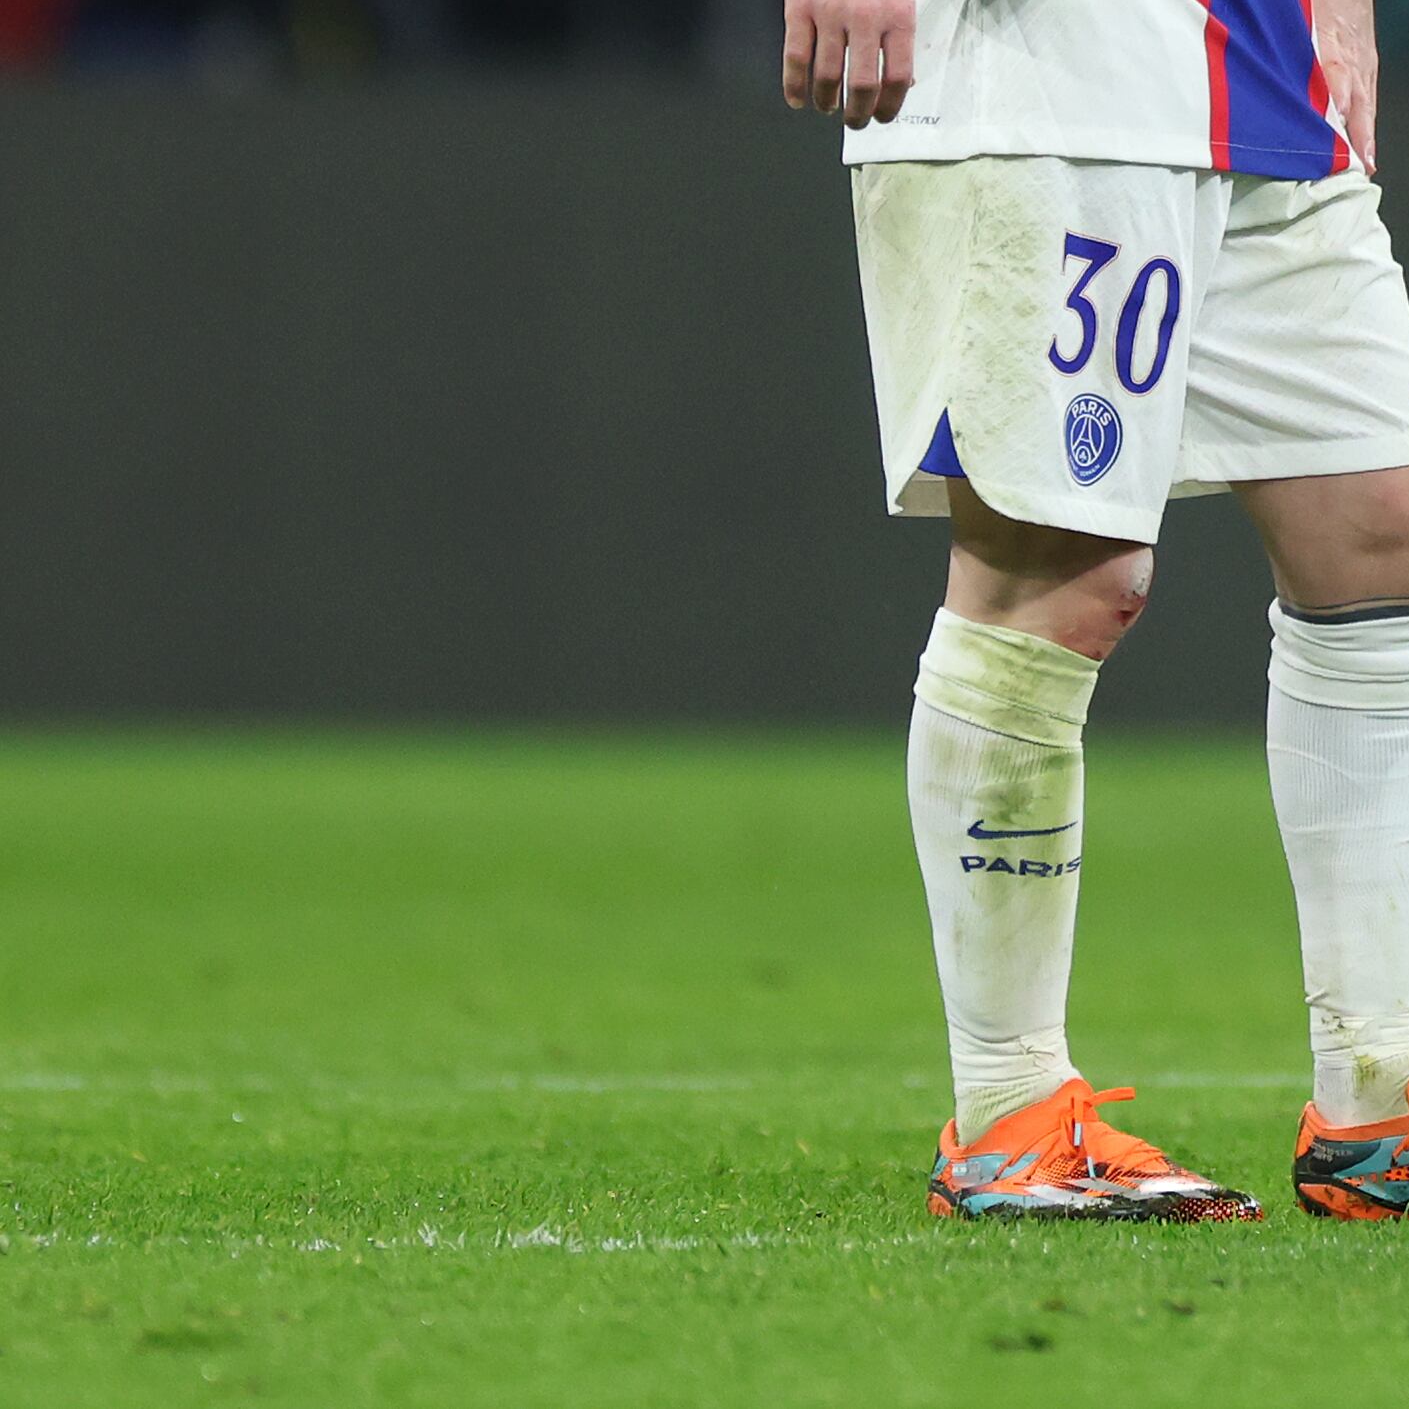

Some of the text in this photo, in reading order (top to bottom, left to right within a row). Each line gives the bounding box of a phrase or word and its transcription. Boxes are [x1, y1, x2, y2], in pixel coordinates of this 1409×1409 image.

[1047, 231, 1182, 397] 30
[1071, 401, 1112, 426] PARIS
[960, 855, 1081, 877] PARIS
